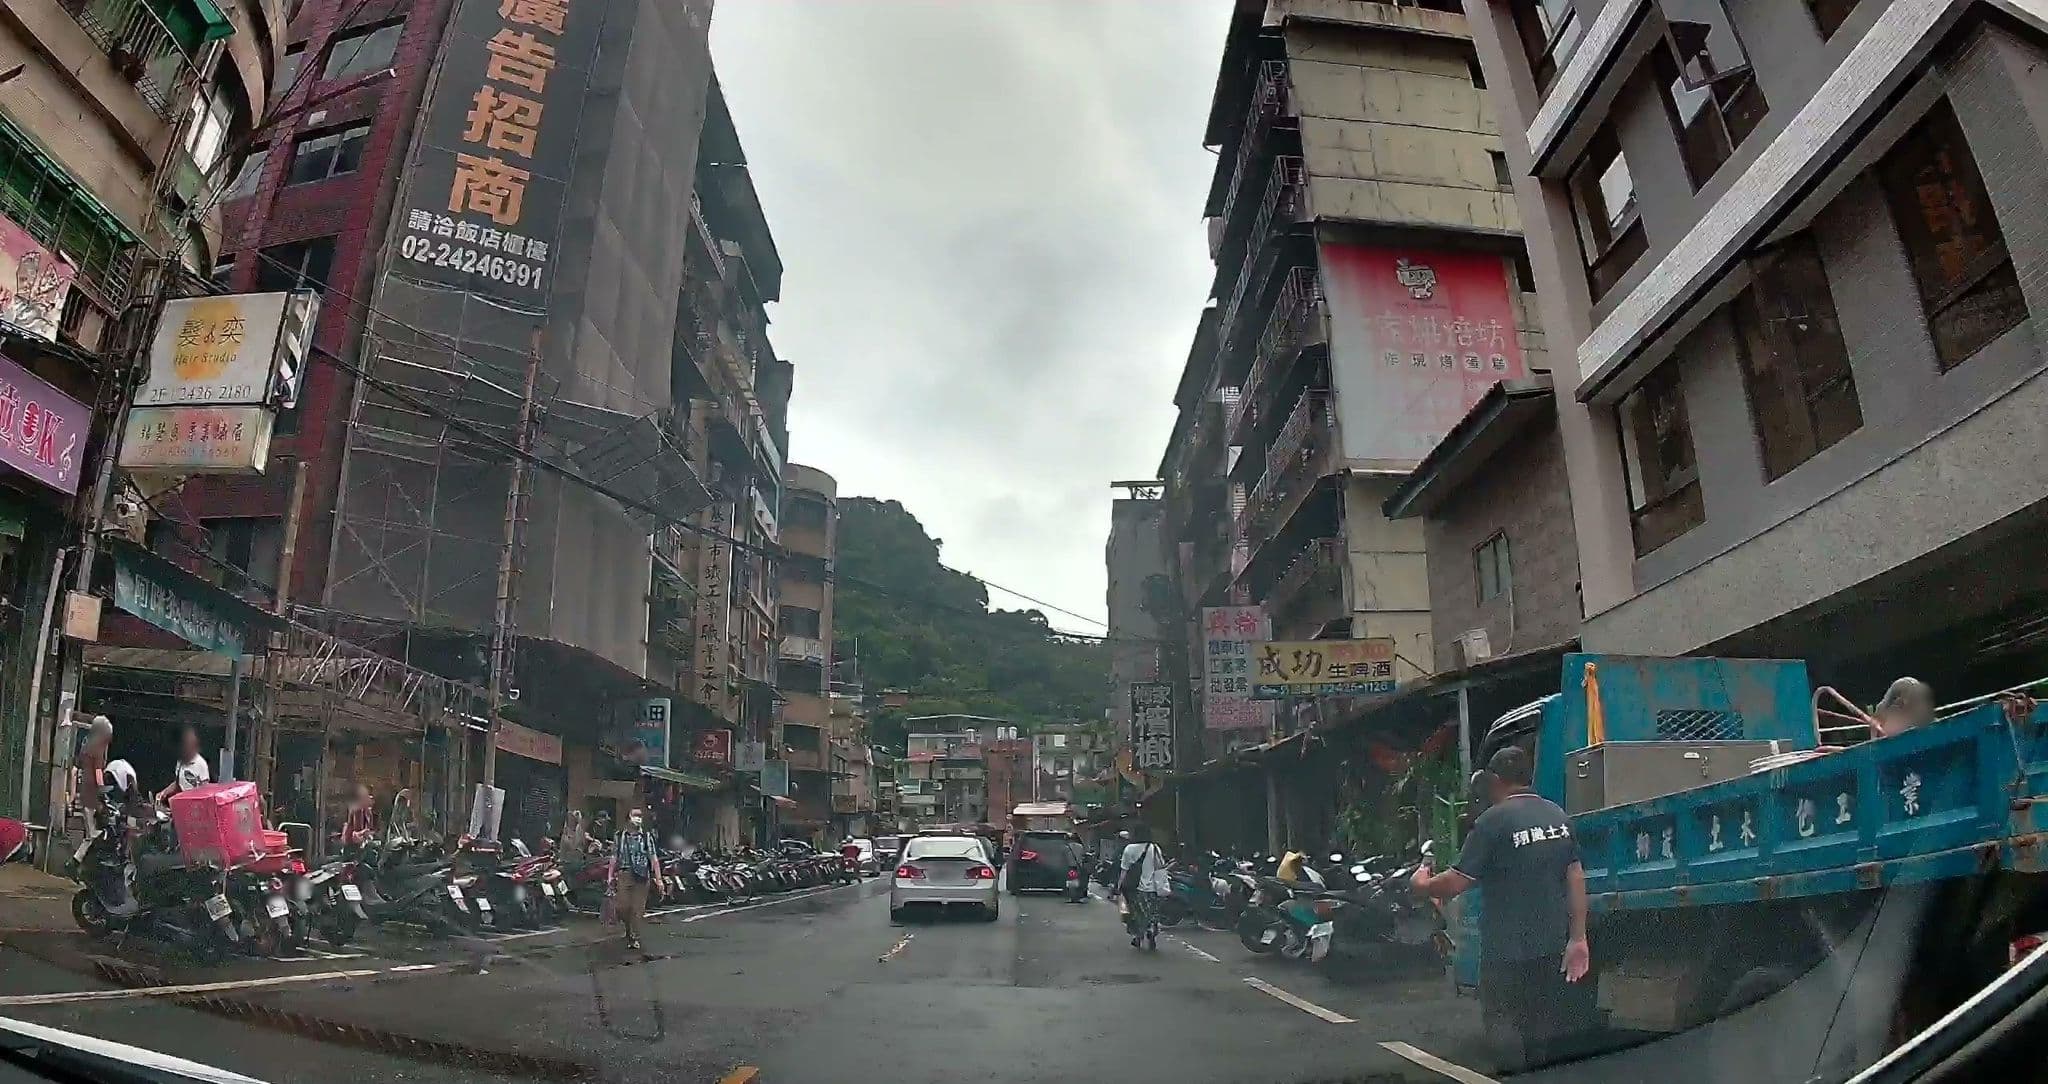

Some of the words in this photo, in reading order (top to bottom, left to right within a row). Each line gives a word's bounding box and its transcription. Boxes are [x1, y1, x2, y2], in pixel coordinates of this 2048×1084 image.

[401, 235, 543, 290] 02-24246391
[200, 352, 237, 363] Studio
[1256, 645, 1323, 682] 成功
[1328, 660, 1391, 680] 生啤酒
[1135, 706, 1172, 768] 檳榔
